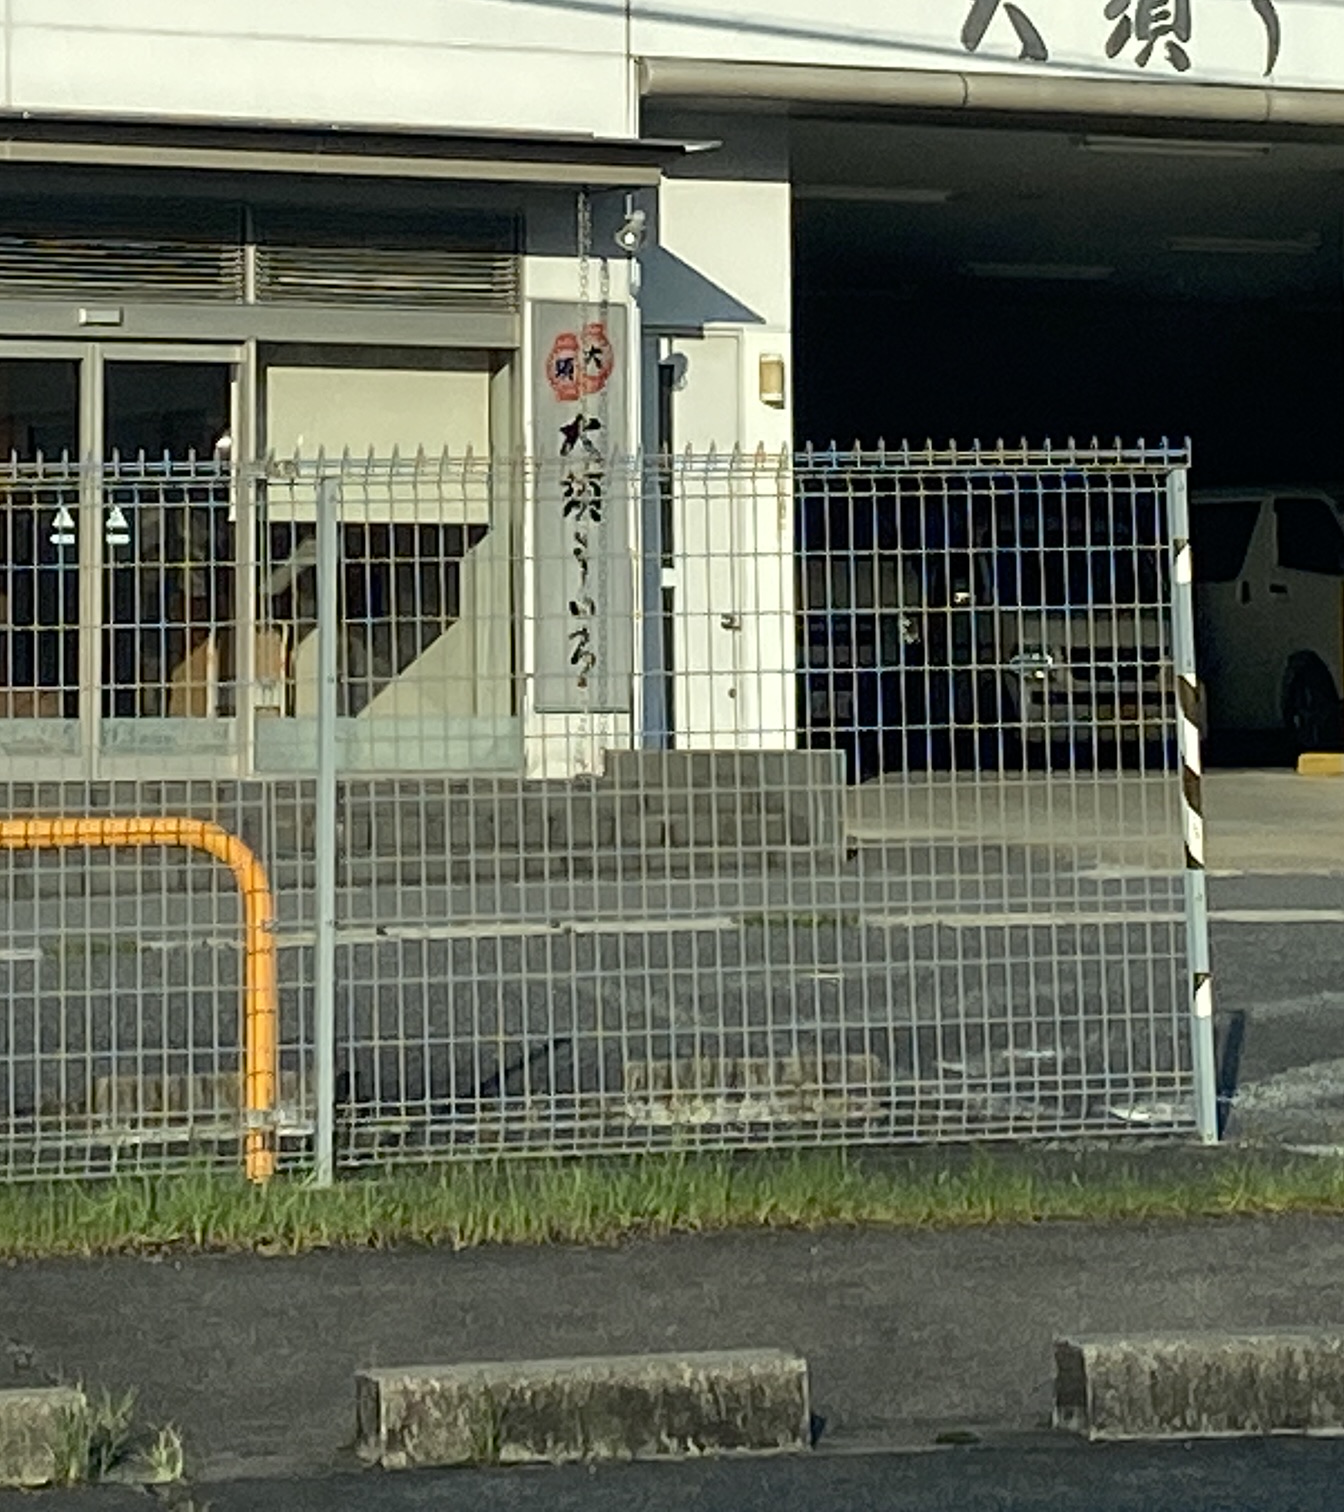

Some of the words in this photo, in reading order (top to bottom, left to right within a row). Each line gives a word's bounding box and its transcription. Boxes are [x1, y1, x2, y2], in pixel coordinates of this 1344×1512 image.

[558, 412, 603, 689] 大須ういろ
